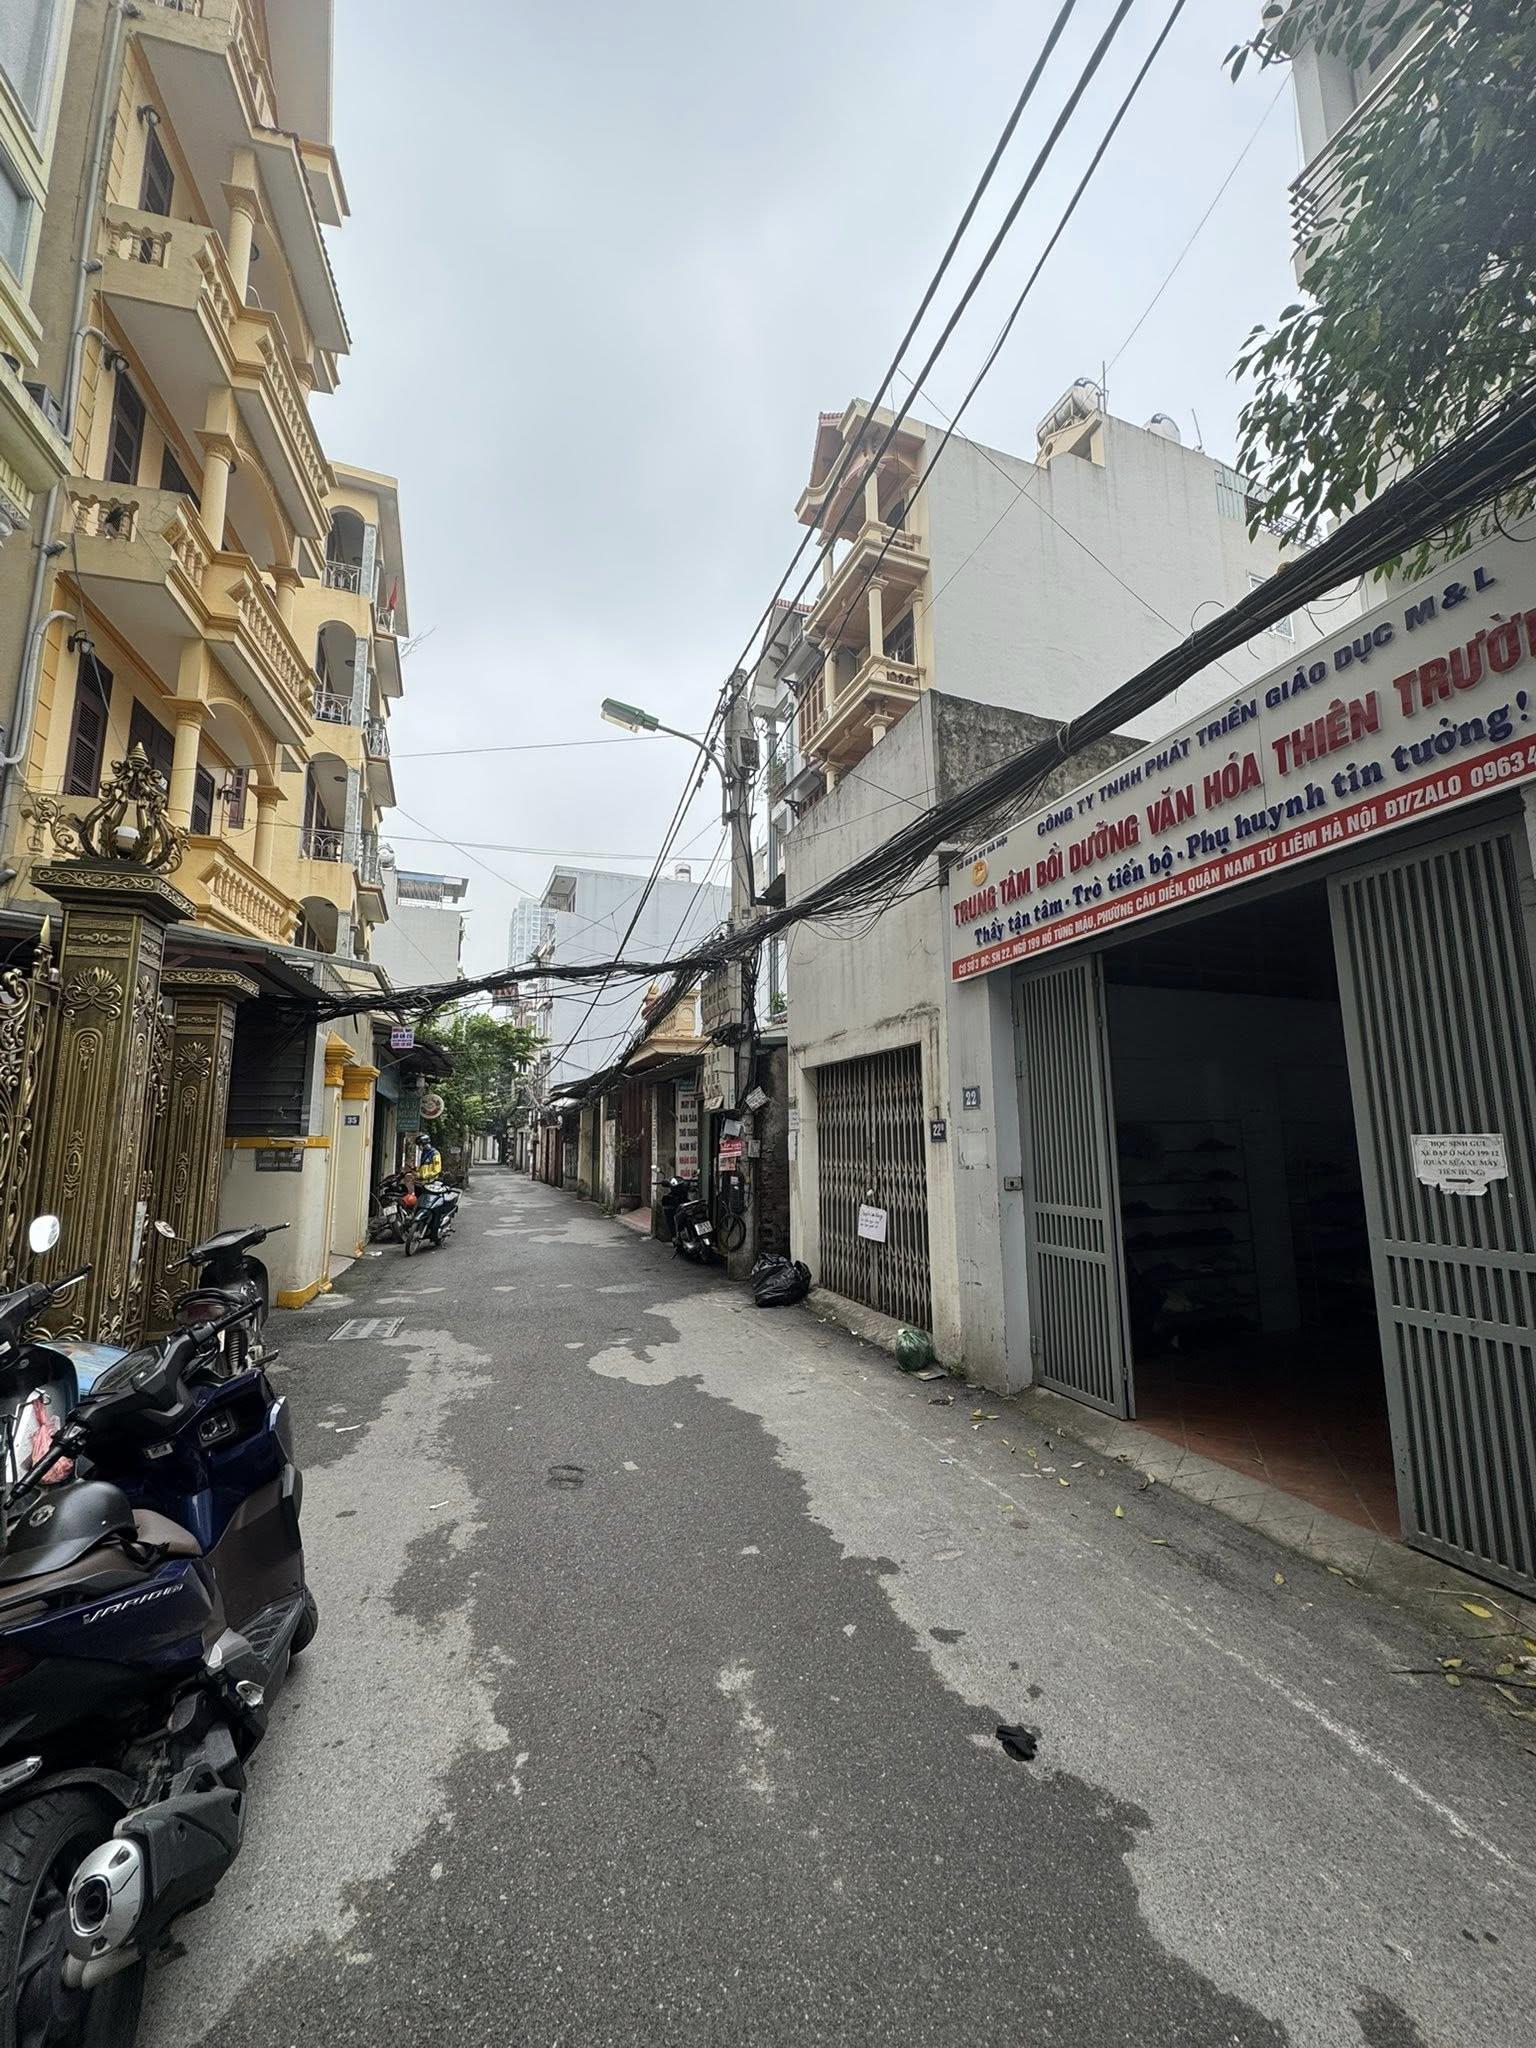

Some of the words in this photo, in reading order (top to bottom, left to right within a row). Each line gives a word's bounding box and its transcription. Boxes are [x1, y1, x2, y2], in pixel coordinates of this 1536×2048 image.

[1037, 806, 1073, 837] CÔNG
[1076, 793, 1094, 814] TY
[1098, 766, 1142, 802] TNHH
[1145, 739, 1191, 778] PHÁT
[1265, 661, 1327, 709] GIÁO
[1334, 622, 1394, 671] DỤC
[1404, 595, 1436, 631] M
[1442, 582, 1470, 610] &
[1474, 566, 1497, 592] L
[954, 885, 998, 928] TRUNG
[999, 868, 1032, 905] TÂM
[1036, 842, 1065, 889] BỒI
[1069, 814, 1141, 873] DƯỠNG
[1146, 784, 1197, 836] VĂN
[1203, 751, 1264, 810] HÓA
[1272, 690, 1382, 776] THIÊN
[974, 917, 1005, 946] Thầy
[1008, 911, 1031, 935] tận
[1034, 899, 1063, 922] tâm
[1072, 876, 1103, 906] Trò
[1107, 857, 1145, 890] tiến
[1148, 845, 1174, 877] bộ
[1186, 826, 1231, 859] Phụ
[1234, 782, 1327, 840] huynh
[1331, 762, 1384, 798] tin
[1027, 935, 1041, 950] 199
[1097, 900, 1134, 925] PHƯỜNG
[1188, 866, 1221, 892] QUẬN
[1224, 853, 1256, 879] NAM
[1258, 841, 1278, 866] TỪ
[1281, 829, 1318, 857] LIÊM
[1321, 816, 1345, 844] HÀ
[1347, 804, 1378, 833] NỘI
[1384, 774, 1462, 819] ĐT/ZALO
[1470, 751, 1526, 788] 0963
[347, 1117, 357, 1125] 35
[965, 1090, 977, 1106] 22
